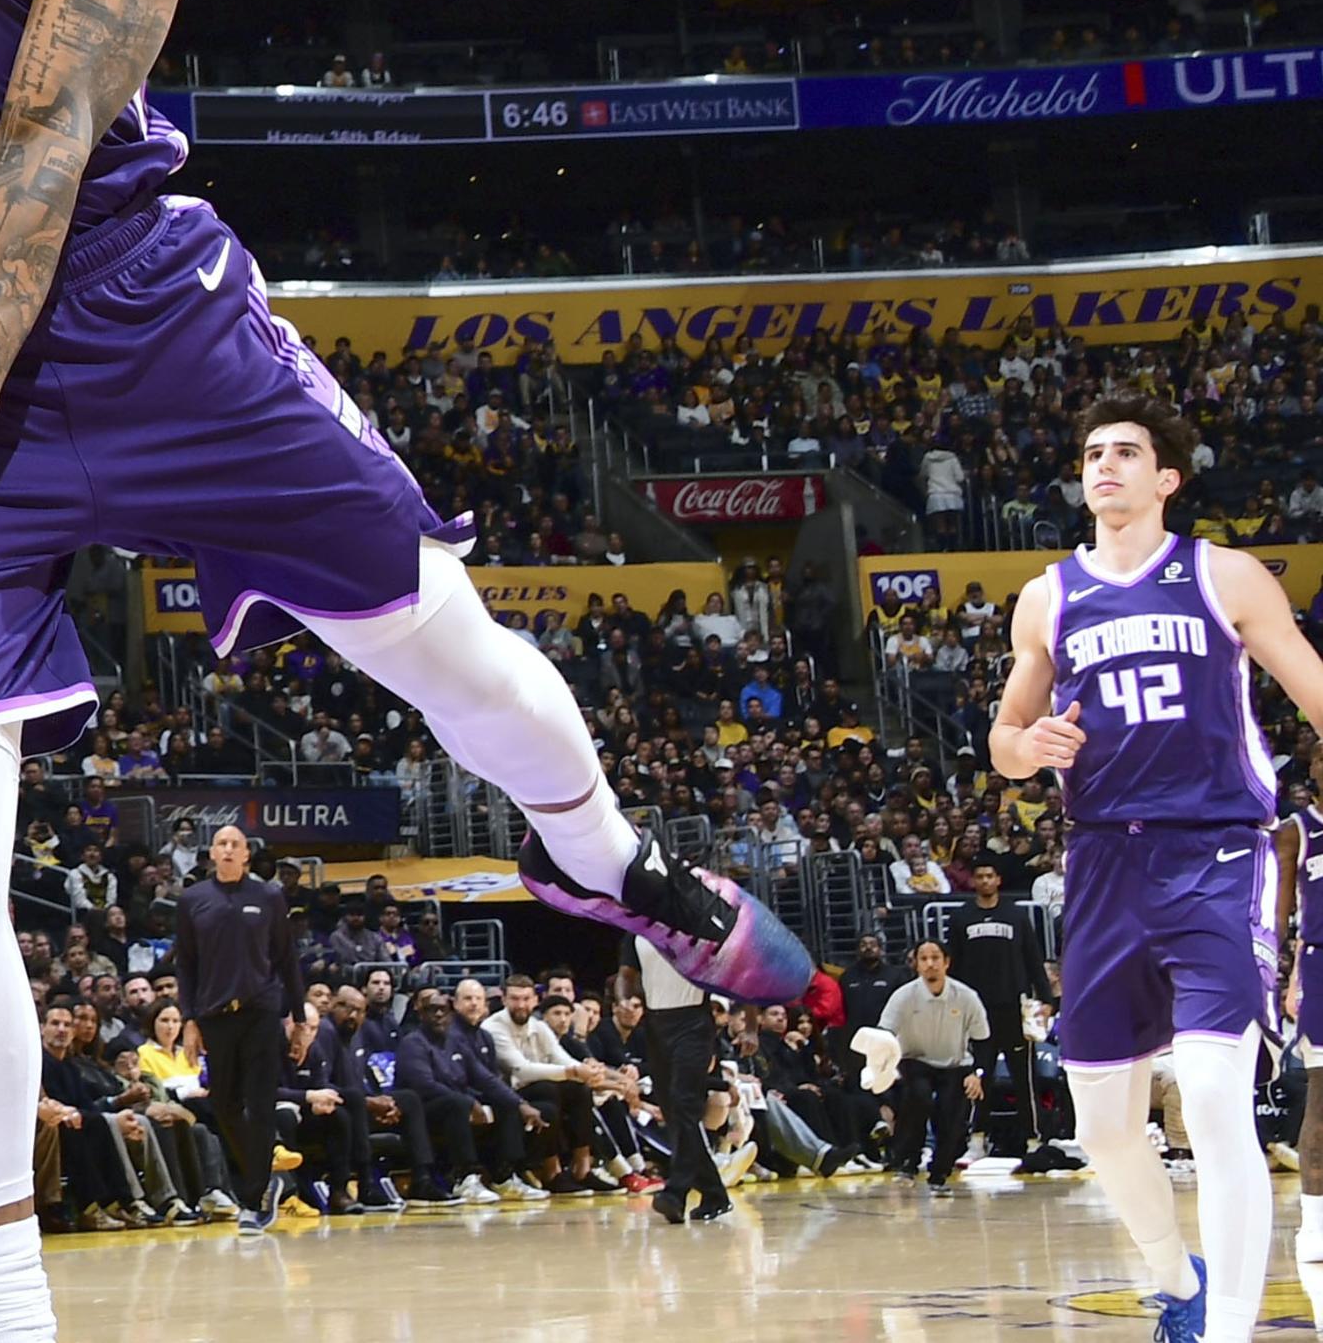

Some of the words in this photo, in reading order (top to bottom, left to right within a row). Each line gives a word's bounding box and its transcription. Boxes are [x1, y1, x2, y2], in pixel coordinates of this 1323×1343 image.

[502, 100, 569, 129] 6:46
[886, 69, 1101, 128] Michelob
[406, 310, 555, 358] LOS
[572, 297, 938, 350] ANGELES
[959, 276, 1302, 335] LAKERS
[673, 480, 784, 522] Coca-Cola
[161, 583, 203, 610] 10
[1065, 613, 1208, 675] SACRAMENTO
[1097, 662, 1187, 726] 42
[262, 803, 351, 828] ULTRA
